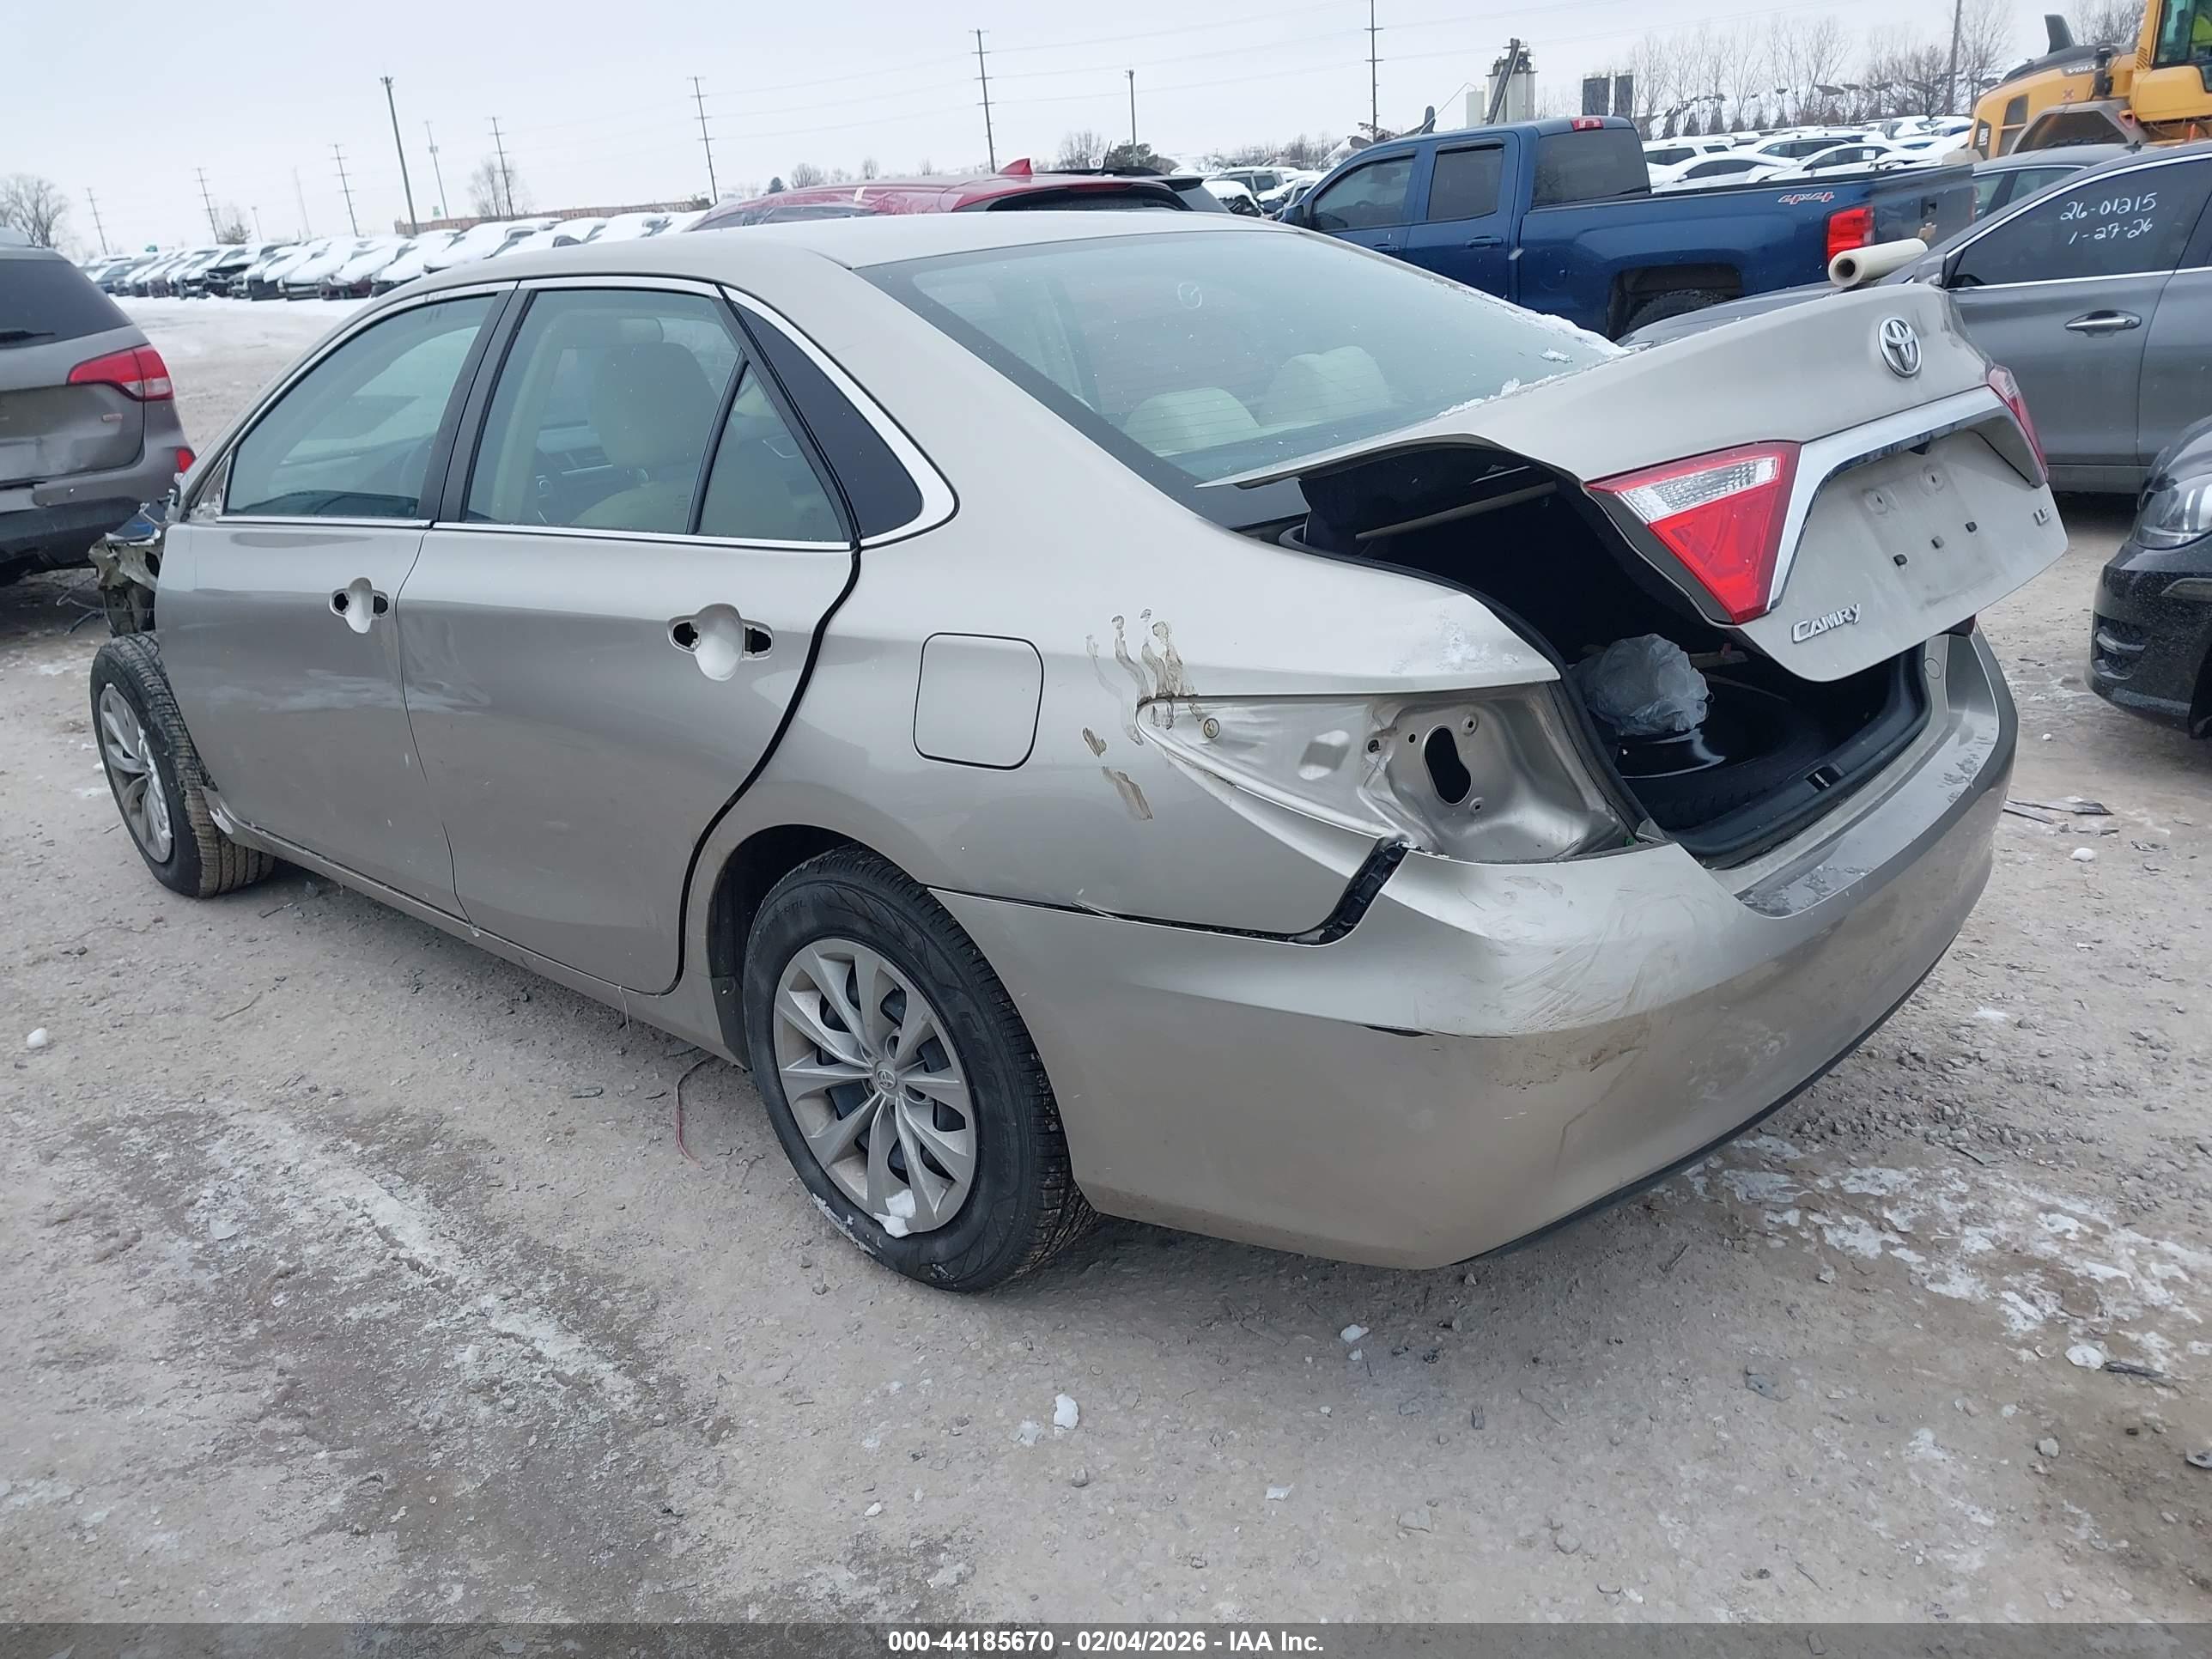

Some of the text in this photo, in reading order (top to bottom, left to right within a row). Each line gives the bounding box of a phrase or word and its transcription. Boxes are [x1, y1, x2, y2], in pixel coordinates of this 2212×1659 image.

[2059, 191, 2158, 221] 26-01215
[2068, 217, 2154, 245] 1-27-26
[1791, 603, 1860, 644] CAMRY
